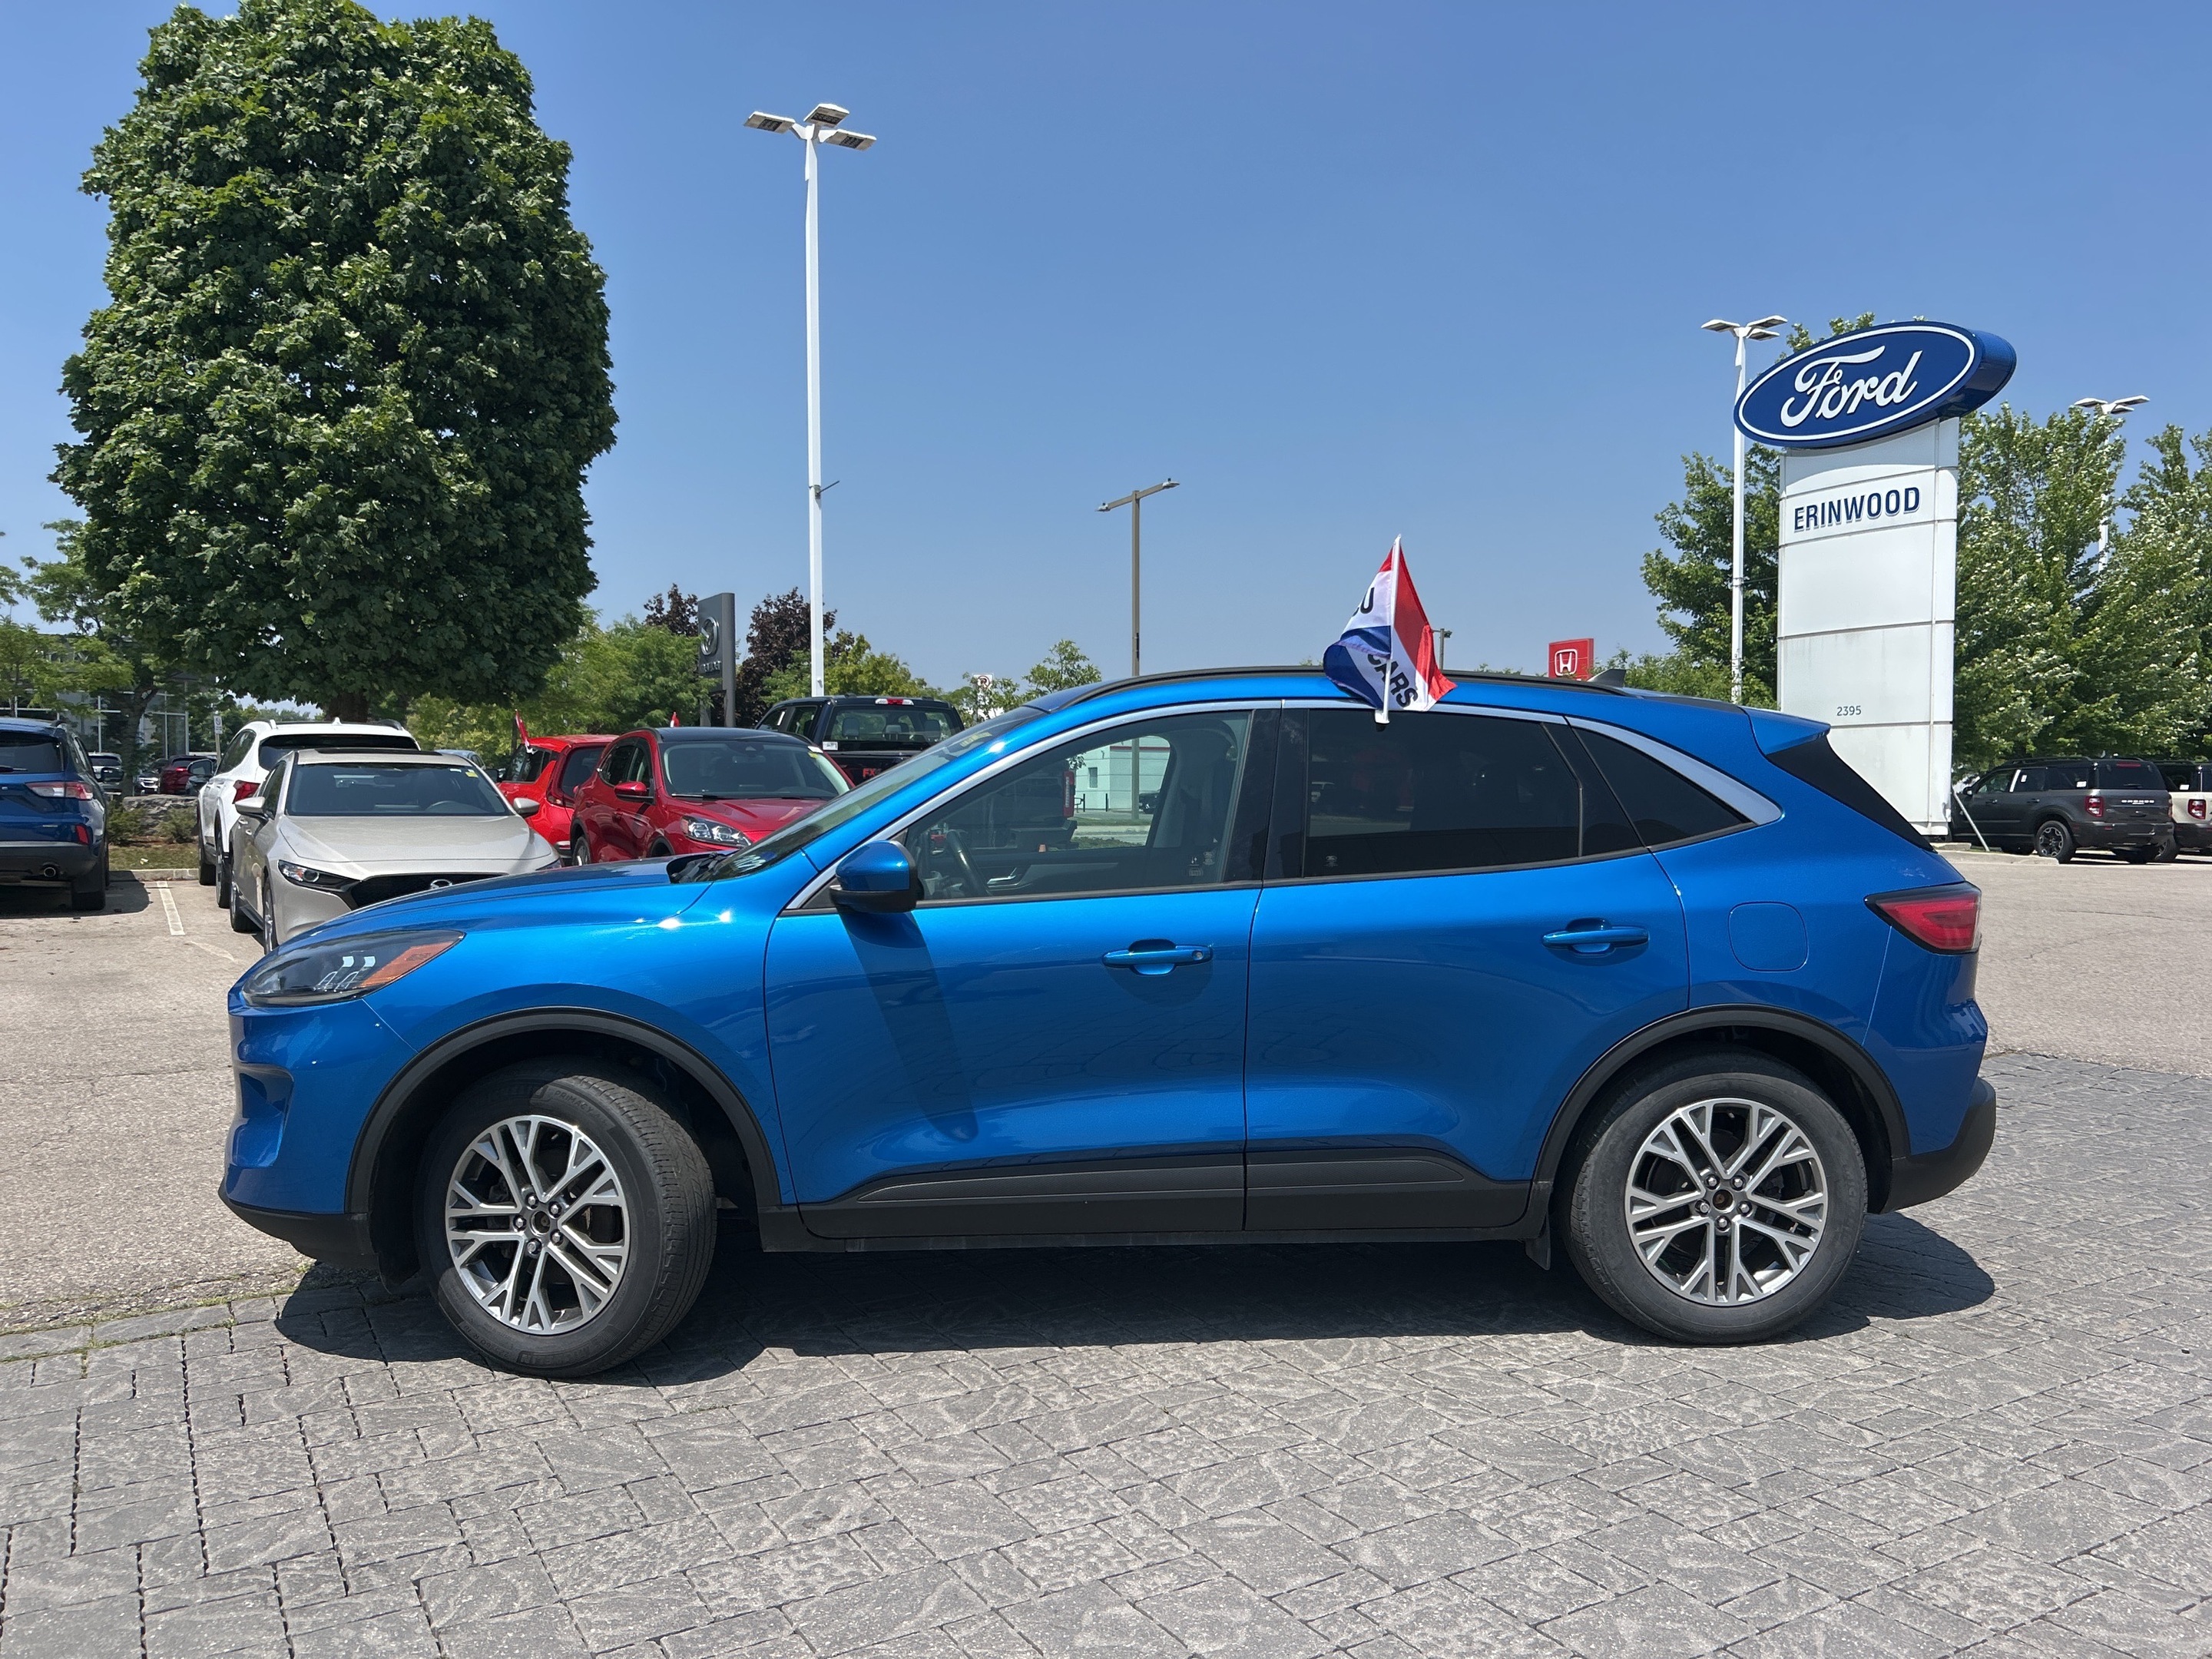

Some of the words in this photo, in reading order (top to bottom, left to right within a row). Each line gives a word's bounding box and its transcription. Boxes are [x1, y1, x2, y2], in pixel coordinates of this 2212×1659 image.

[1780, 346, 1923, 428] Ford
[1793, 486, 1920, 531] ERINWOOD
[1836, 704, 1862, 717] 2395
